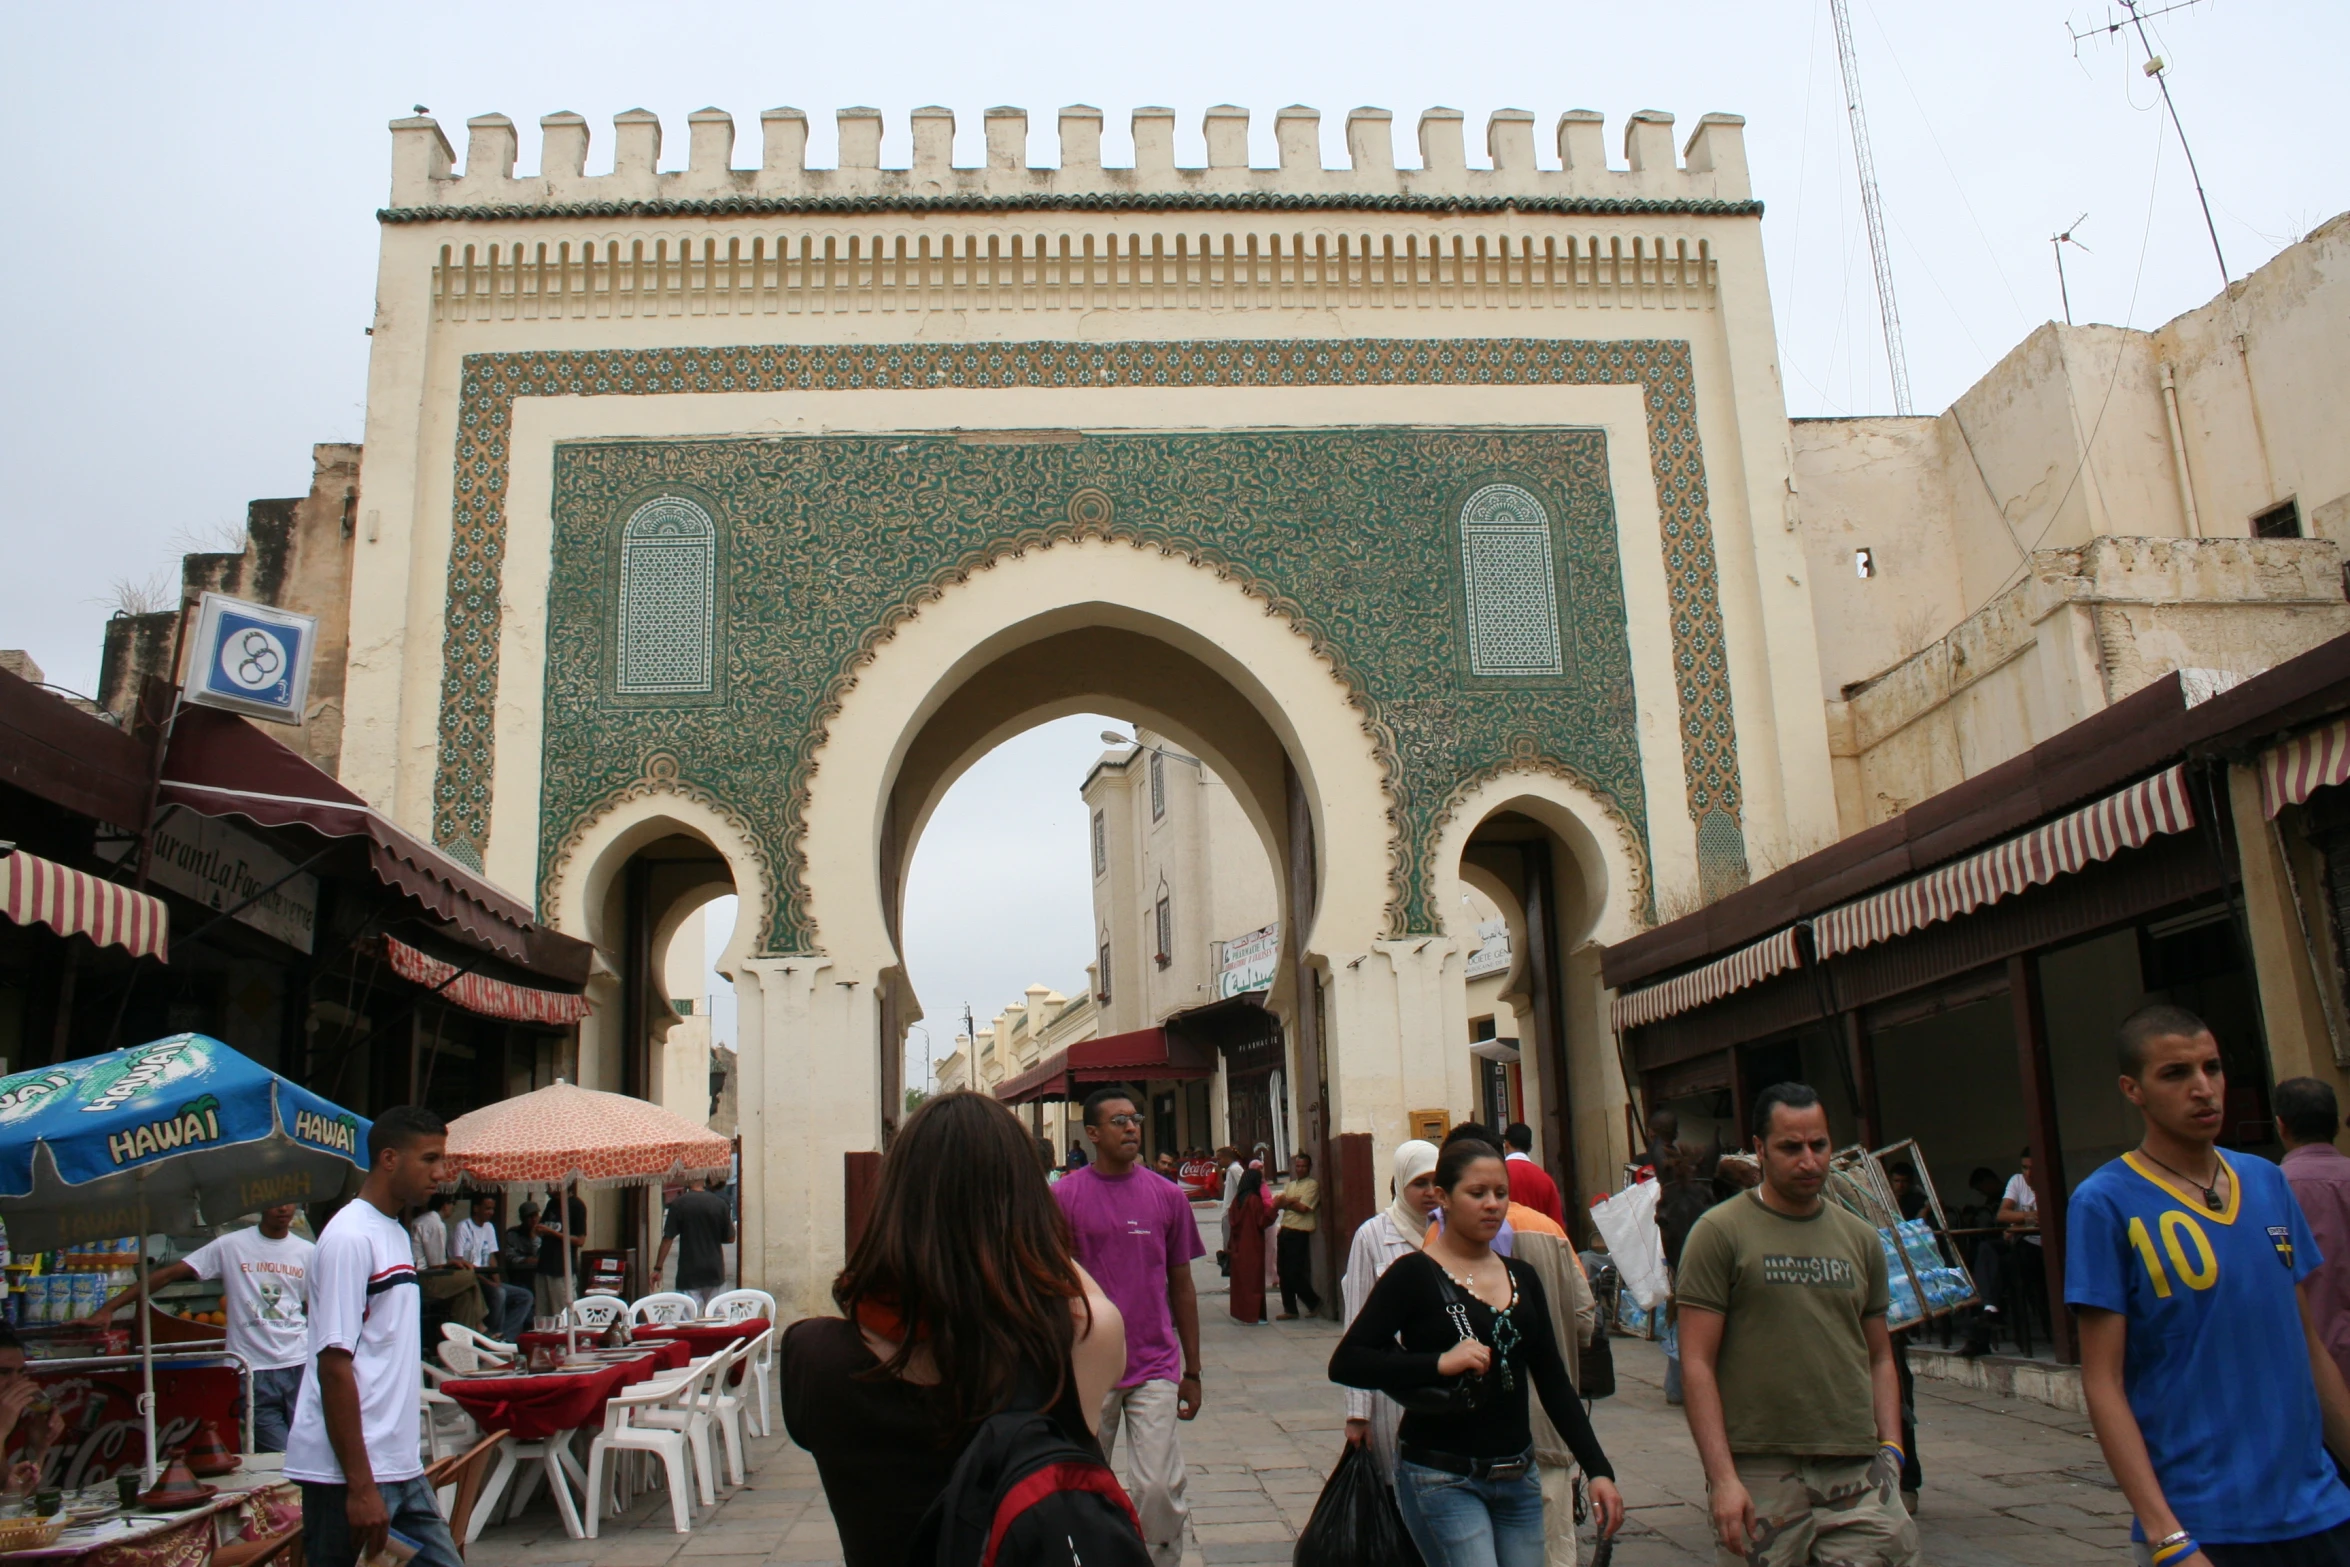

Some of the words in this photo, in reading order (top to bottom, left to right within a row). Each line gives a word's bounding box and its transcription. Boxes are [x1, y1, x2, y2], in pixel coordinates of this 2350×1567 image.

[1232, 943, 1260, 959] PHARMACIE
[80, 1039, 191, 1112] HAWAI
[109, 1105, 220, 1165] HAWAI
[295, 1109, 356, 1155] HAWAI
[241, 1263, 253, 1273] EL
[256, 1262, 304, 1278] INQUILINO
[1764, 1256, 1850, 1283] INDUSTRY
[2128, 1210, 2219, 1298] 10
